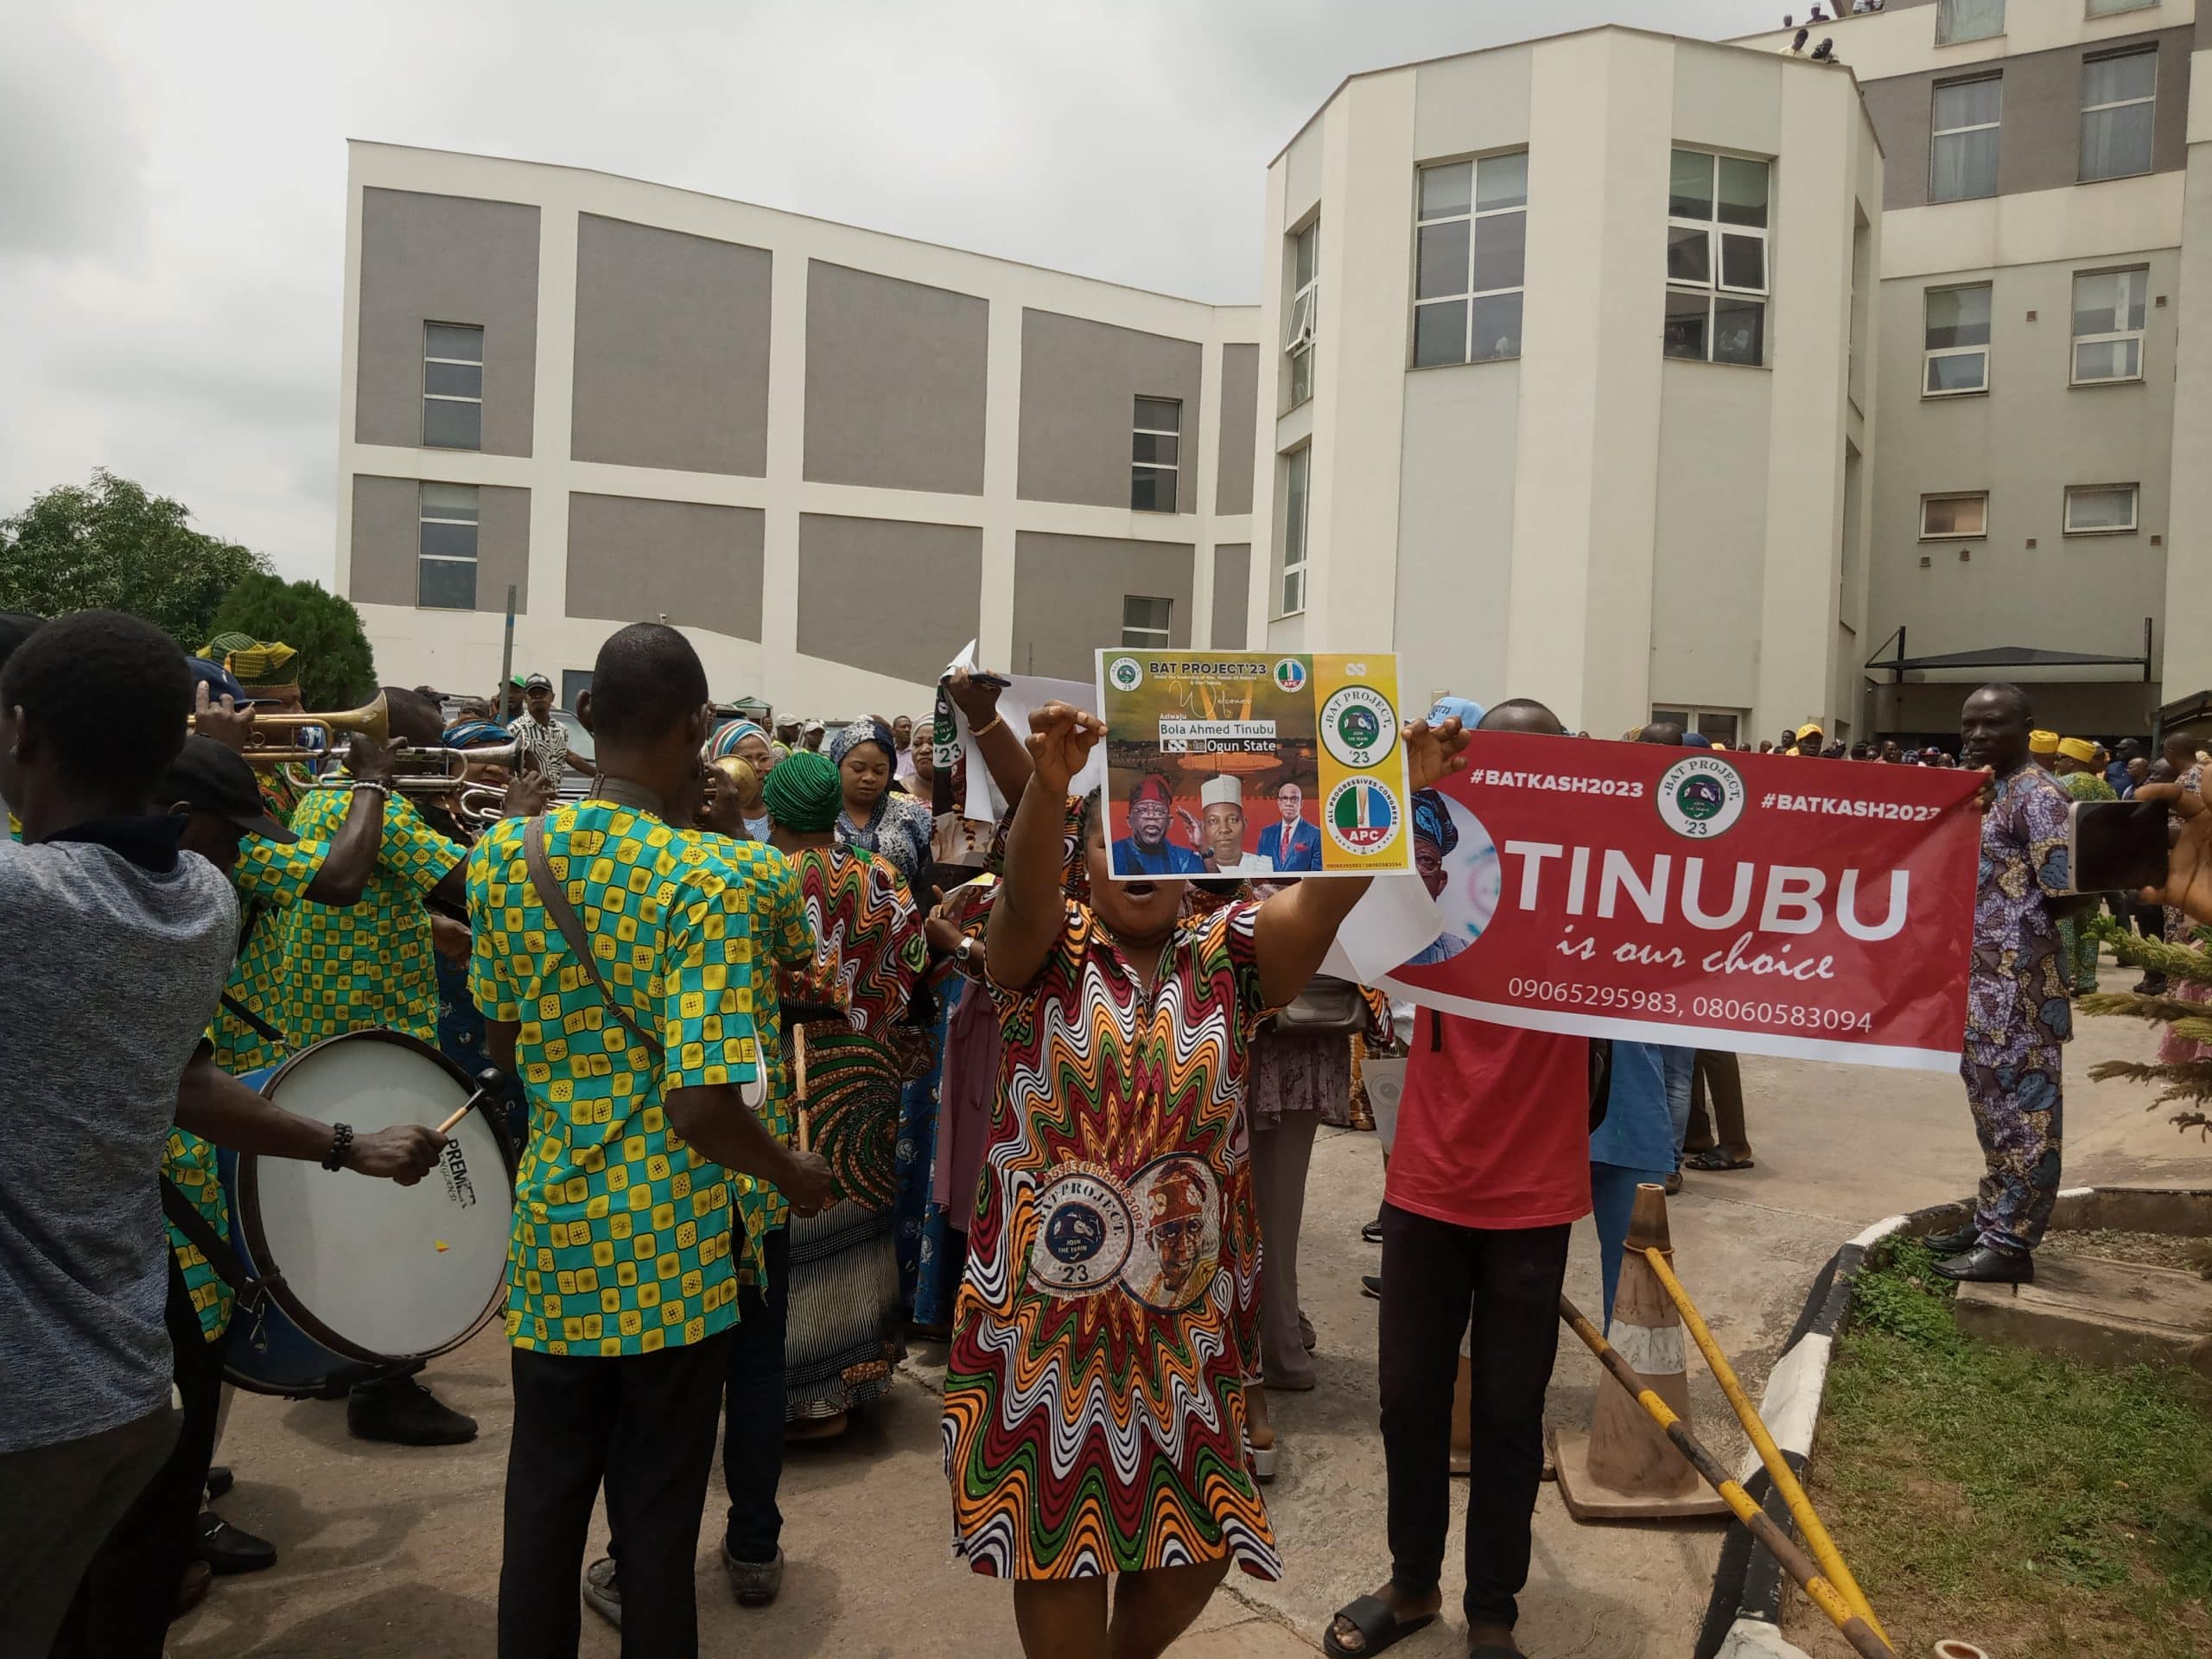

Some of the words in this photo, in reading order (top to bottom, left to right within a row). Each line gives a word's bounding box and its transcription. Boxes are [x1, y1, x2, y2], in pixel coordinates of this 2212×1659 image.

[1149, 662, 1177, 674] BAT
[1181, 663, 1267, 675] PROJECT'23
[1326, 698, 1342, 724] BAT
[1344, 690, 1392, 725] PROJECT
[1160, 724, 1186, 734] Bola
[1189, 723, 1230, 734] Ahmed
[1233, 724, 1274, 734] Tinubu
[1207, 741, 1240, 754] Ogun
[1243, 740, 1276, 752] State
[1349, 749, 1370, 763] '23
[1470, 768, 1644, 798] #BATKASH2023
[1663, 766, 1686, 791] BAT
[1688, 760, 1740, 798] PROJECT
[1330, 779, 1377, 807] PROGRESSIVES
[1378, 785, 1398, 825] CONGRESS
[1349, 830, 1380, 841] APC
[1685, 819, 1707, 835] '23
[1503, 839, 1910, 942] TINUBU
[1556, 924, 1596, 961] is
[1612, 943, 1687, 966] our
[1701, 931, 1834, 981] choice
[1508, 976, 1684, 1018] 09065295983,
[1692, 995, 1872, 1033] 08060583094
[1058, 1263, 1089, 1283] '23
